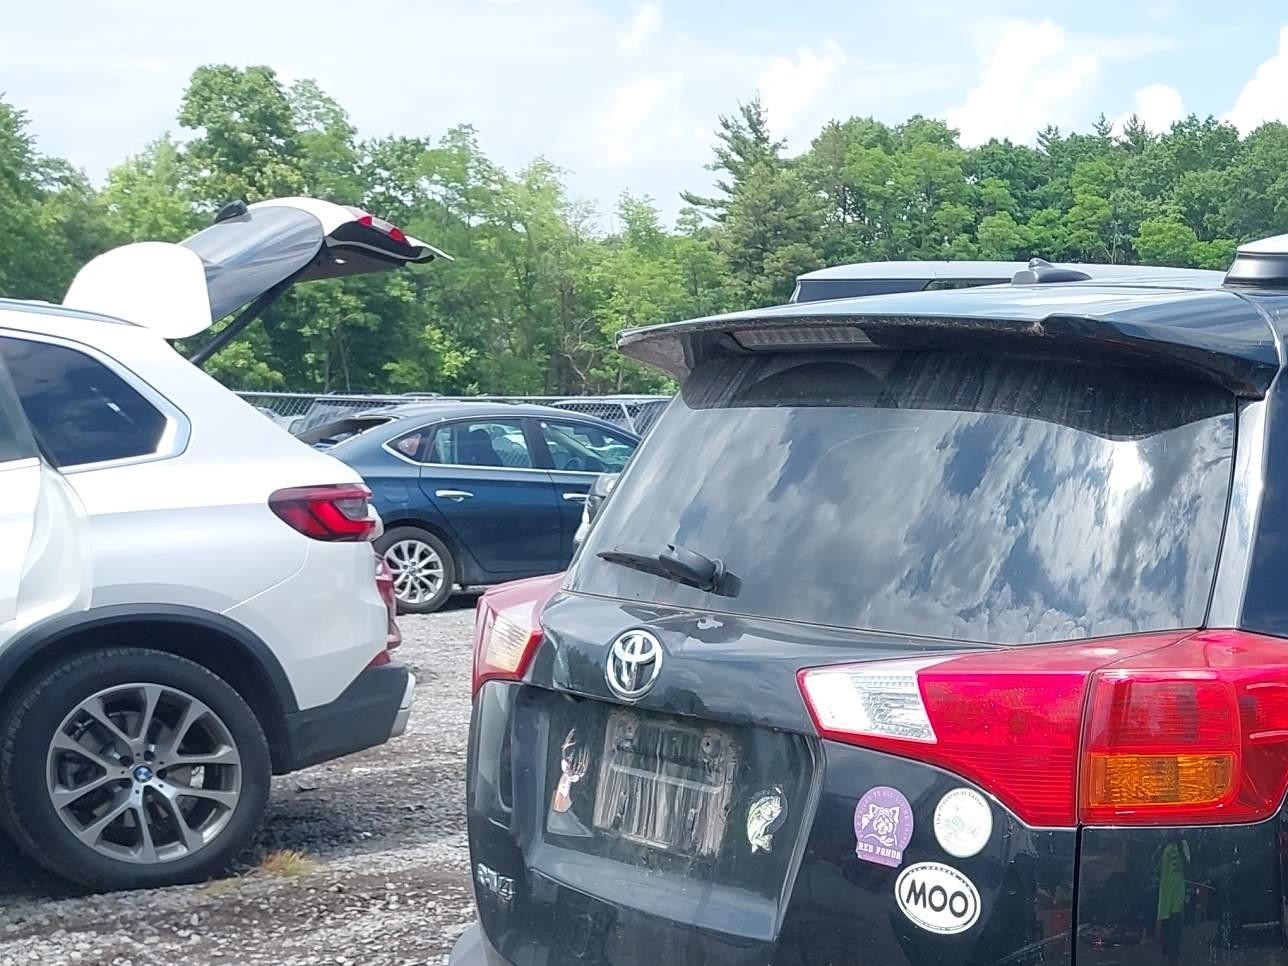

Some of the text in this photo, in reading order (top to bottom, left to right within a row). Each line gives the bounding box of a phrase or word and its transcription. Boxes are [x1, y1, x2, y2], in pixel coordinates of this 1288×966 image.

[858, 842, 901, 860] RED PANDA
[906, 879, 968, 918] MOO
